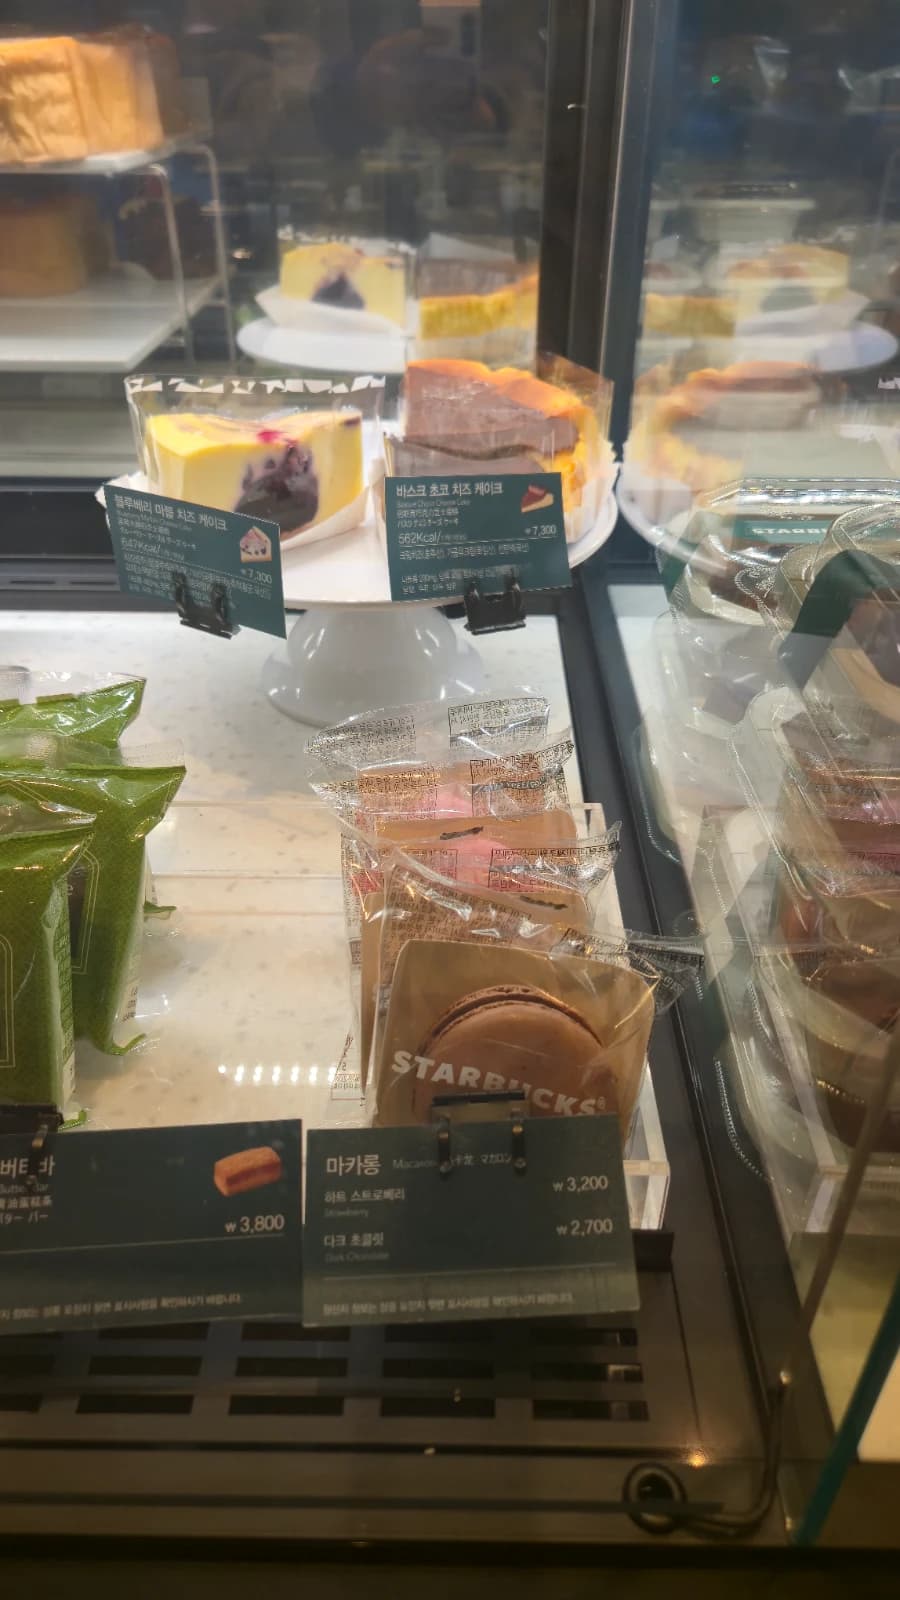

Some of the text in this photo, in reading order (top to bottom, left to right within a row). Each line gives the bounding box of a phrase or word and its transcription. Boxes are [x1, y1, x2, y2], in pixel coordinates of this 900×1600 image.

[396, 480, 504, 499] 바스크 초코 치즈 케이크
[114, 494, 152, 514] 블루베리
[155, 503, 175, 520] 마블
[176, 508, 198, 524] 치즈
[198, 513, 229, 532] 케이크
[326, 1154, 382, 1177] 마카롱
[324, 1187, 405, 1205] 하트 스트로베리
[324, 1231, 384, 1248] 다크 초콜릿
